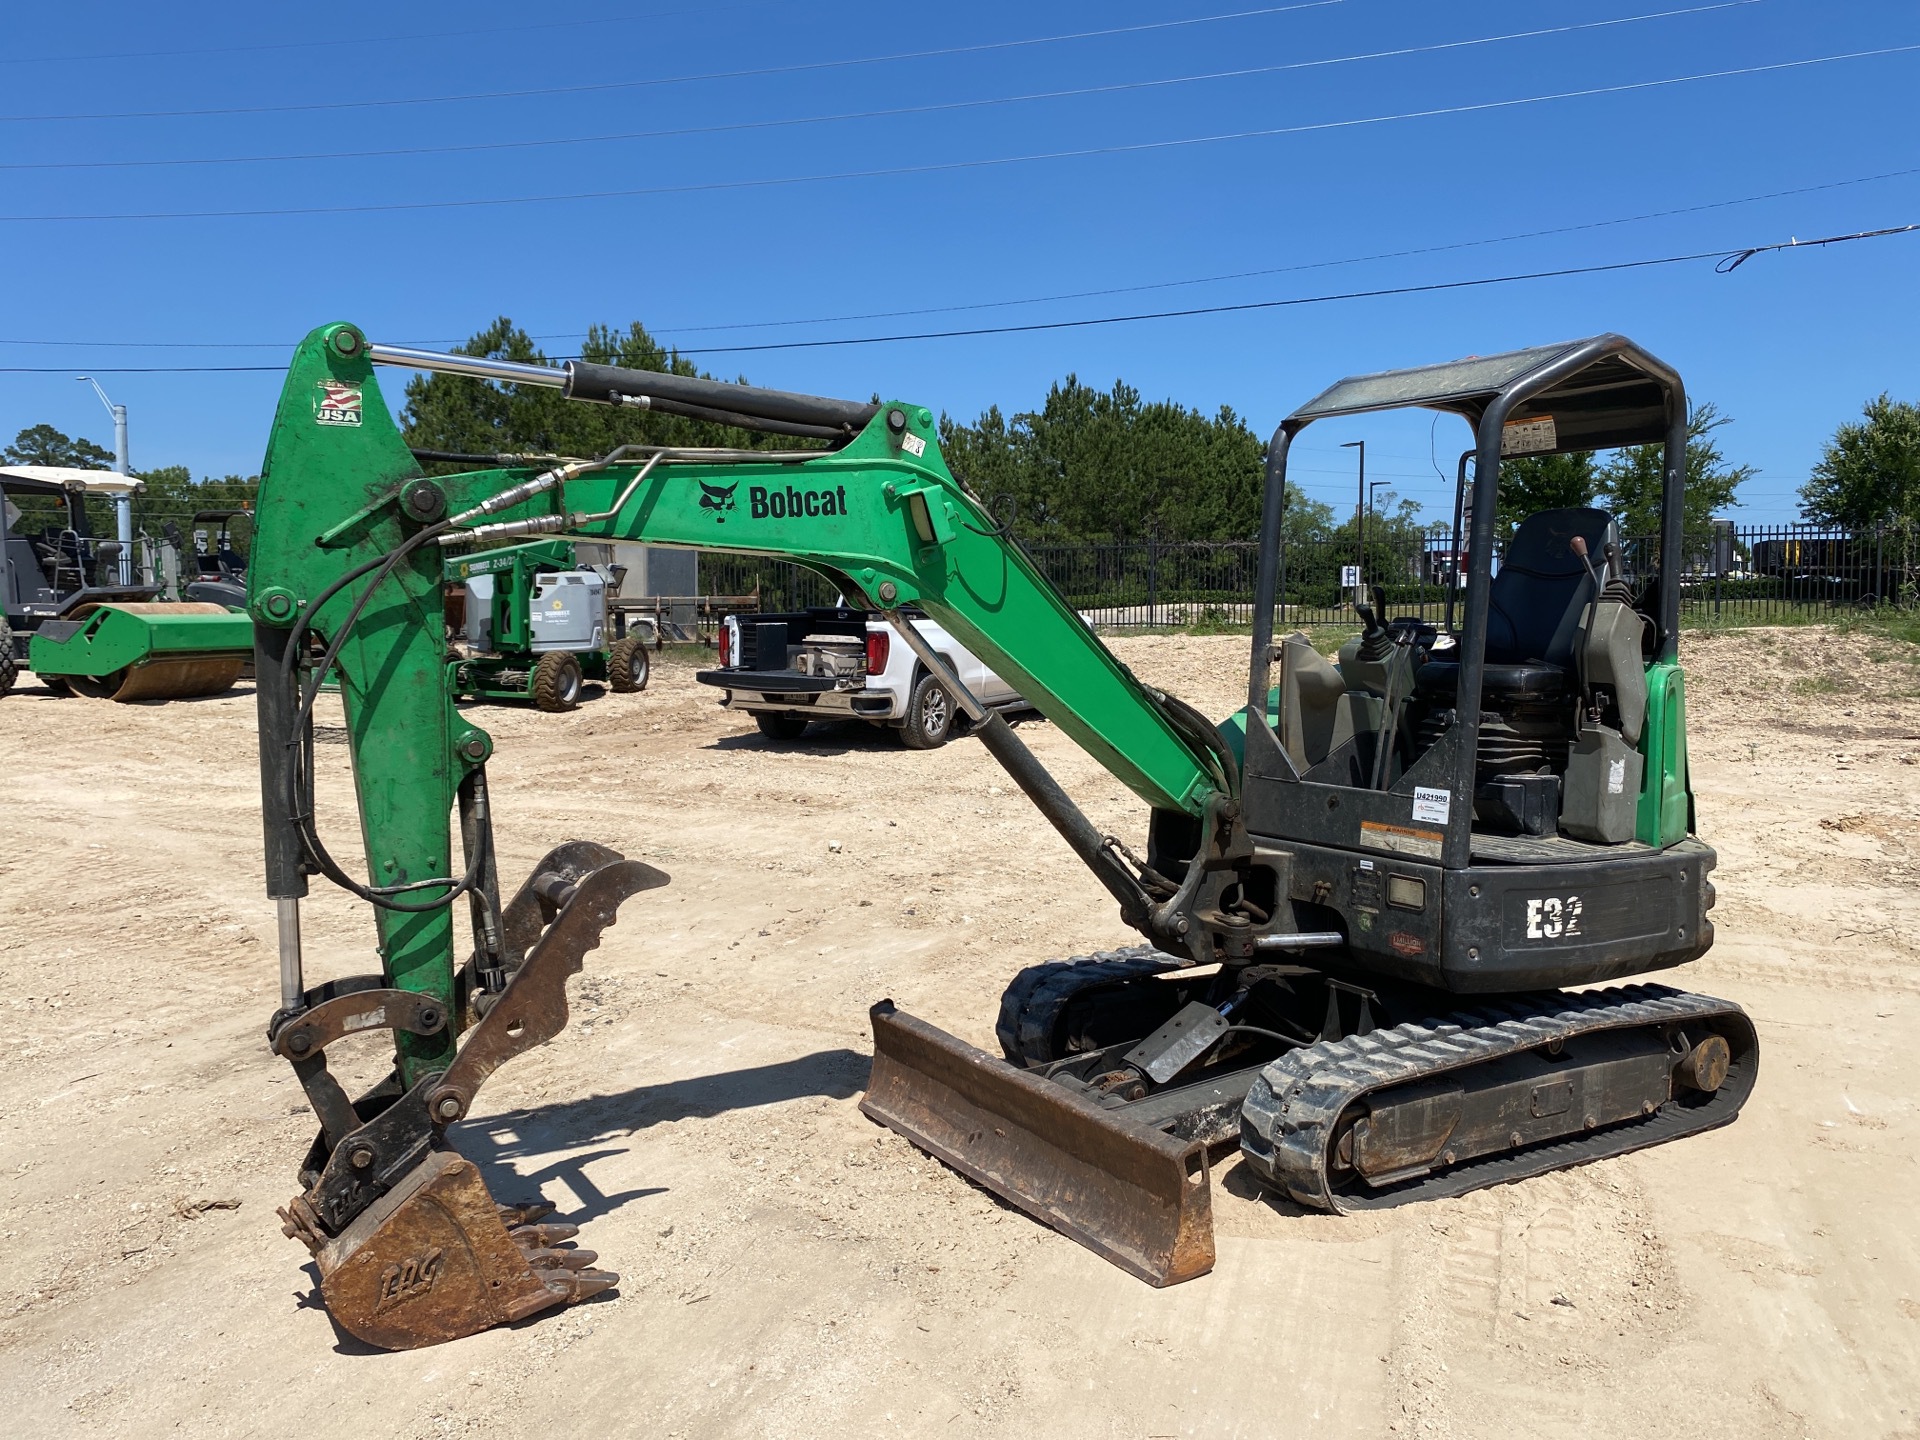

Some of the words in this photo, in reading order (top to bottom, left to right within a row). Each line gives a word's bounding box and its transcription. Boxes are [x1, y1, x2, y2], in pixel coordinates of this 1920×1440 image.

[316, 409, 359, 423] USA
[749, 485, 848, 519] Bobcat
[1416, 792, 1448, 803] U421990
[1392, 827, 1417, 836] WARNING
[1526, 895, 1583, 939] E32
